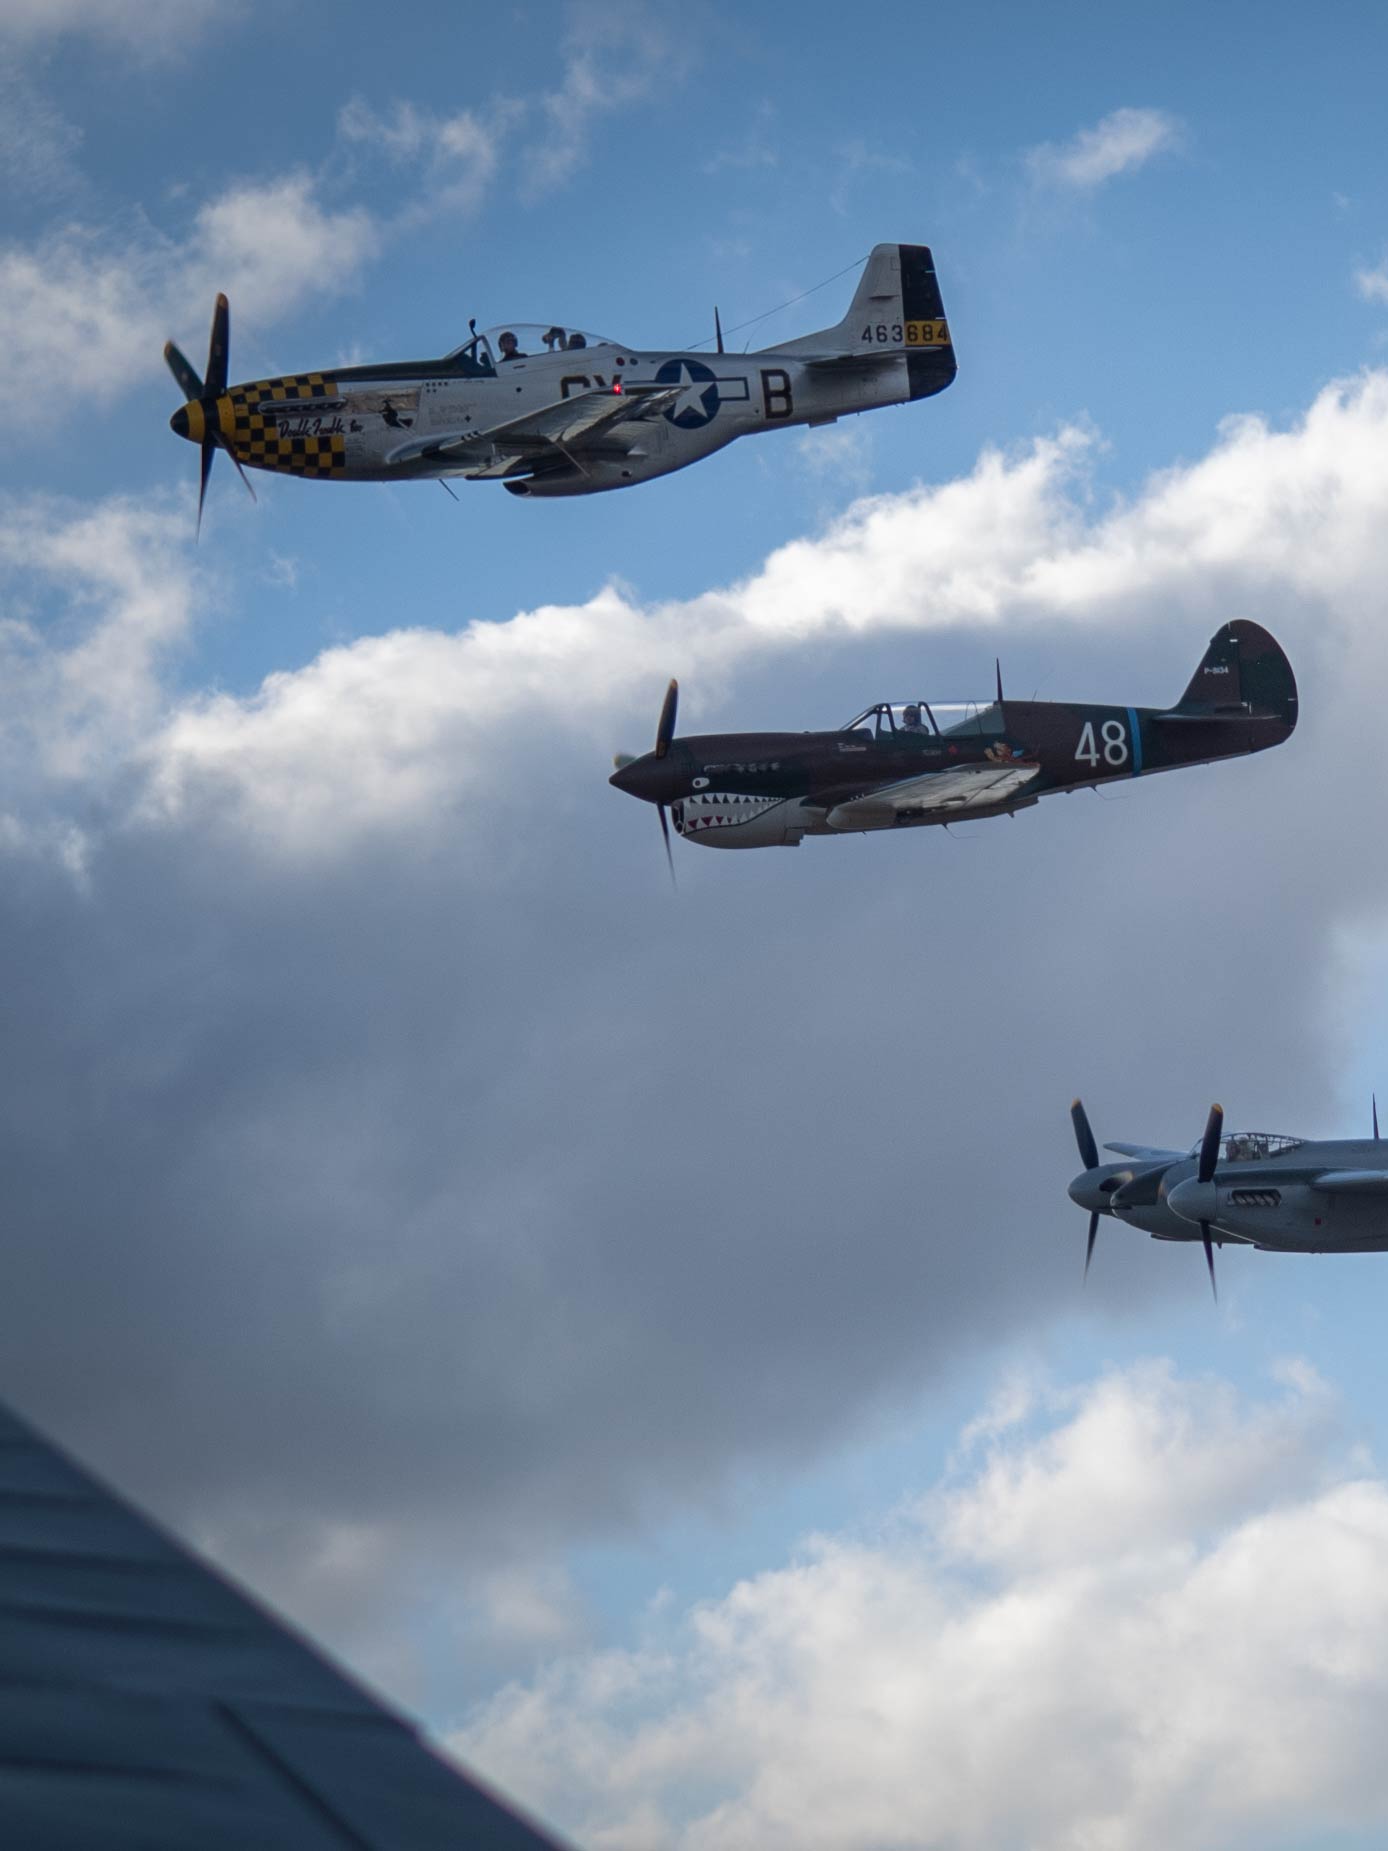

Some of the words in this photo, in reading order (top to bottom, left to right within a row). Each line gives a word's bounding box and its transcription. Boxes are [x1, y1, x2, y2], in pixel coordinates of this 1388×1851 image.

[861, 324, 947, 343] 463684
[760, 369, 794, 419] B
[1074, 720, 1128, 767] 48
